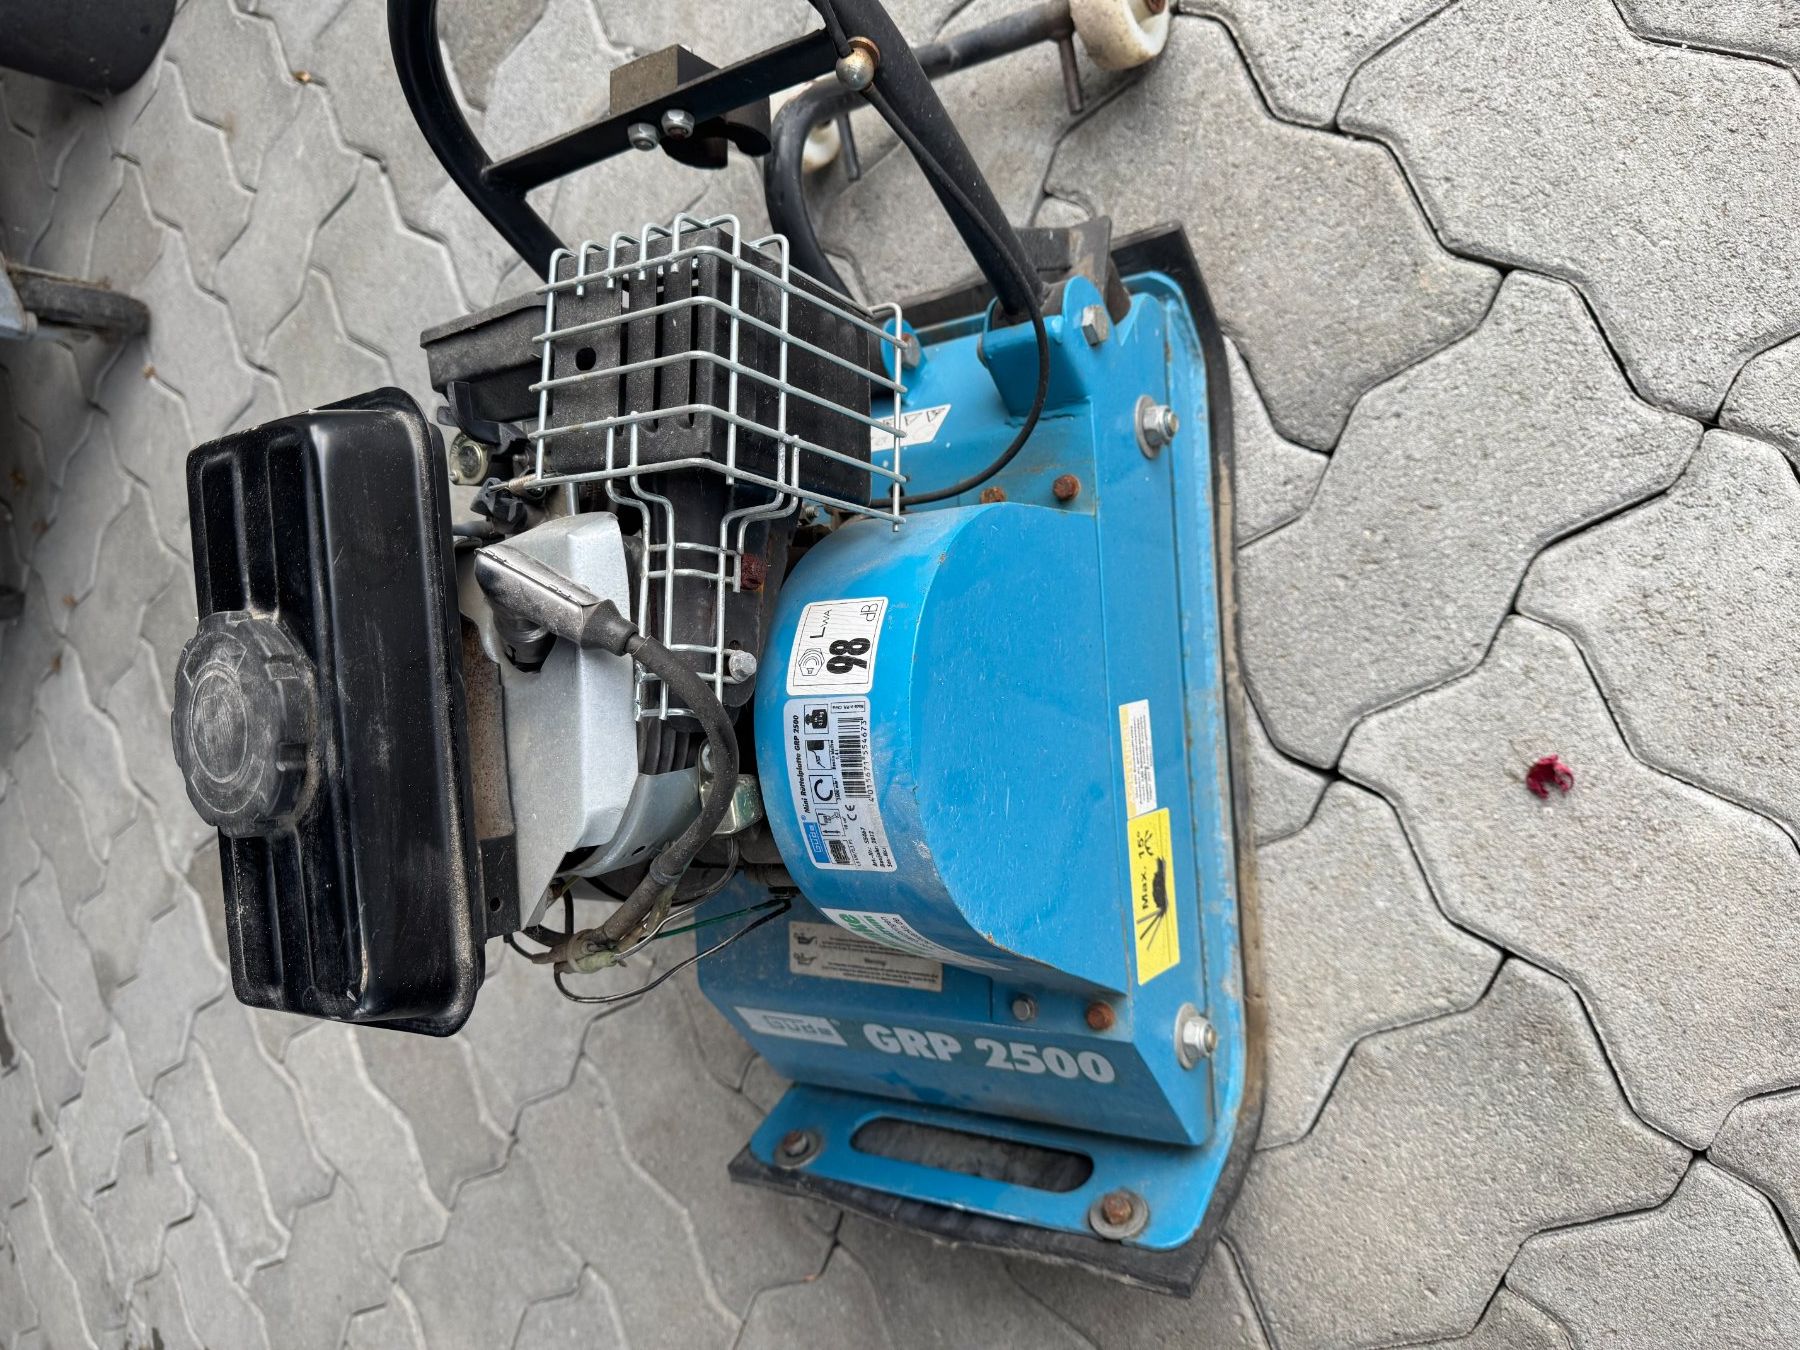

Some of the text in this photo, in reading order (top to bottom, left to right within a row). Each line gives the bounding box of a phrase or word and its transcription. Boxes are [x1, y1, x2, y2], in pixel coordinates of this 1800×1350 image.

[860, 603, 878, 621] dB
[826, 638, 870, 674] 98
[861, 720, 869, 755] 554673
[795, 754, 807, 796] Rüttelplatte
[801, 798, 810, 814] Mini
[869, 831, 877, 844] 2012
[1139, 866, 1149, 910] Max.
[863, 1023, 1115, 1083] GRP 2500
